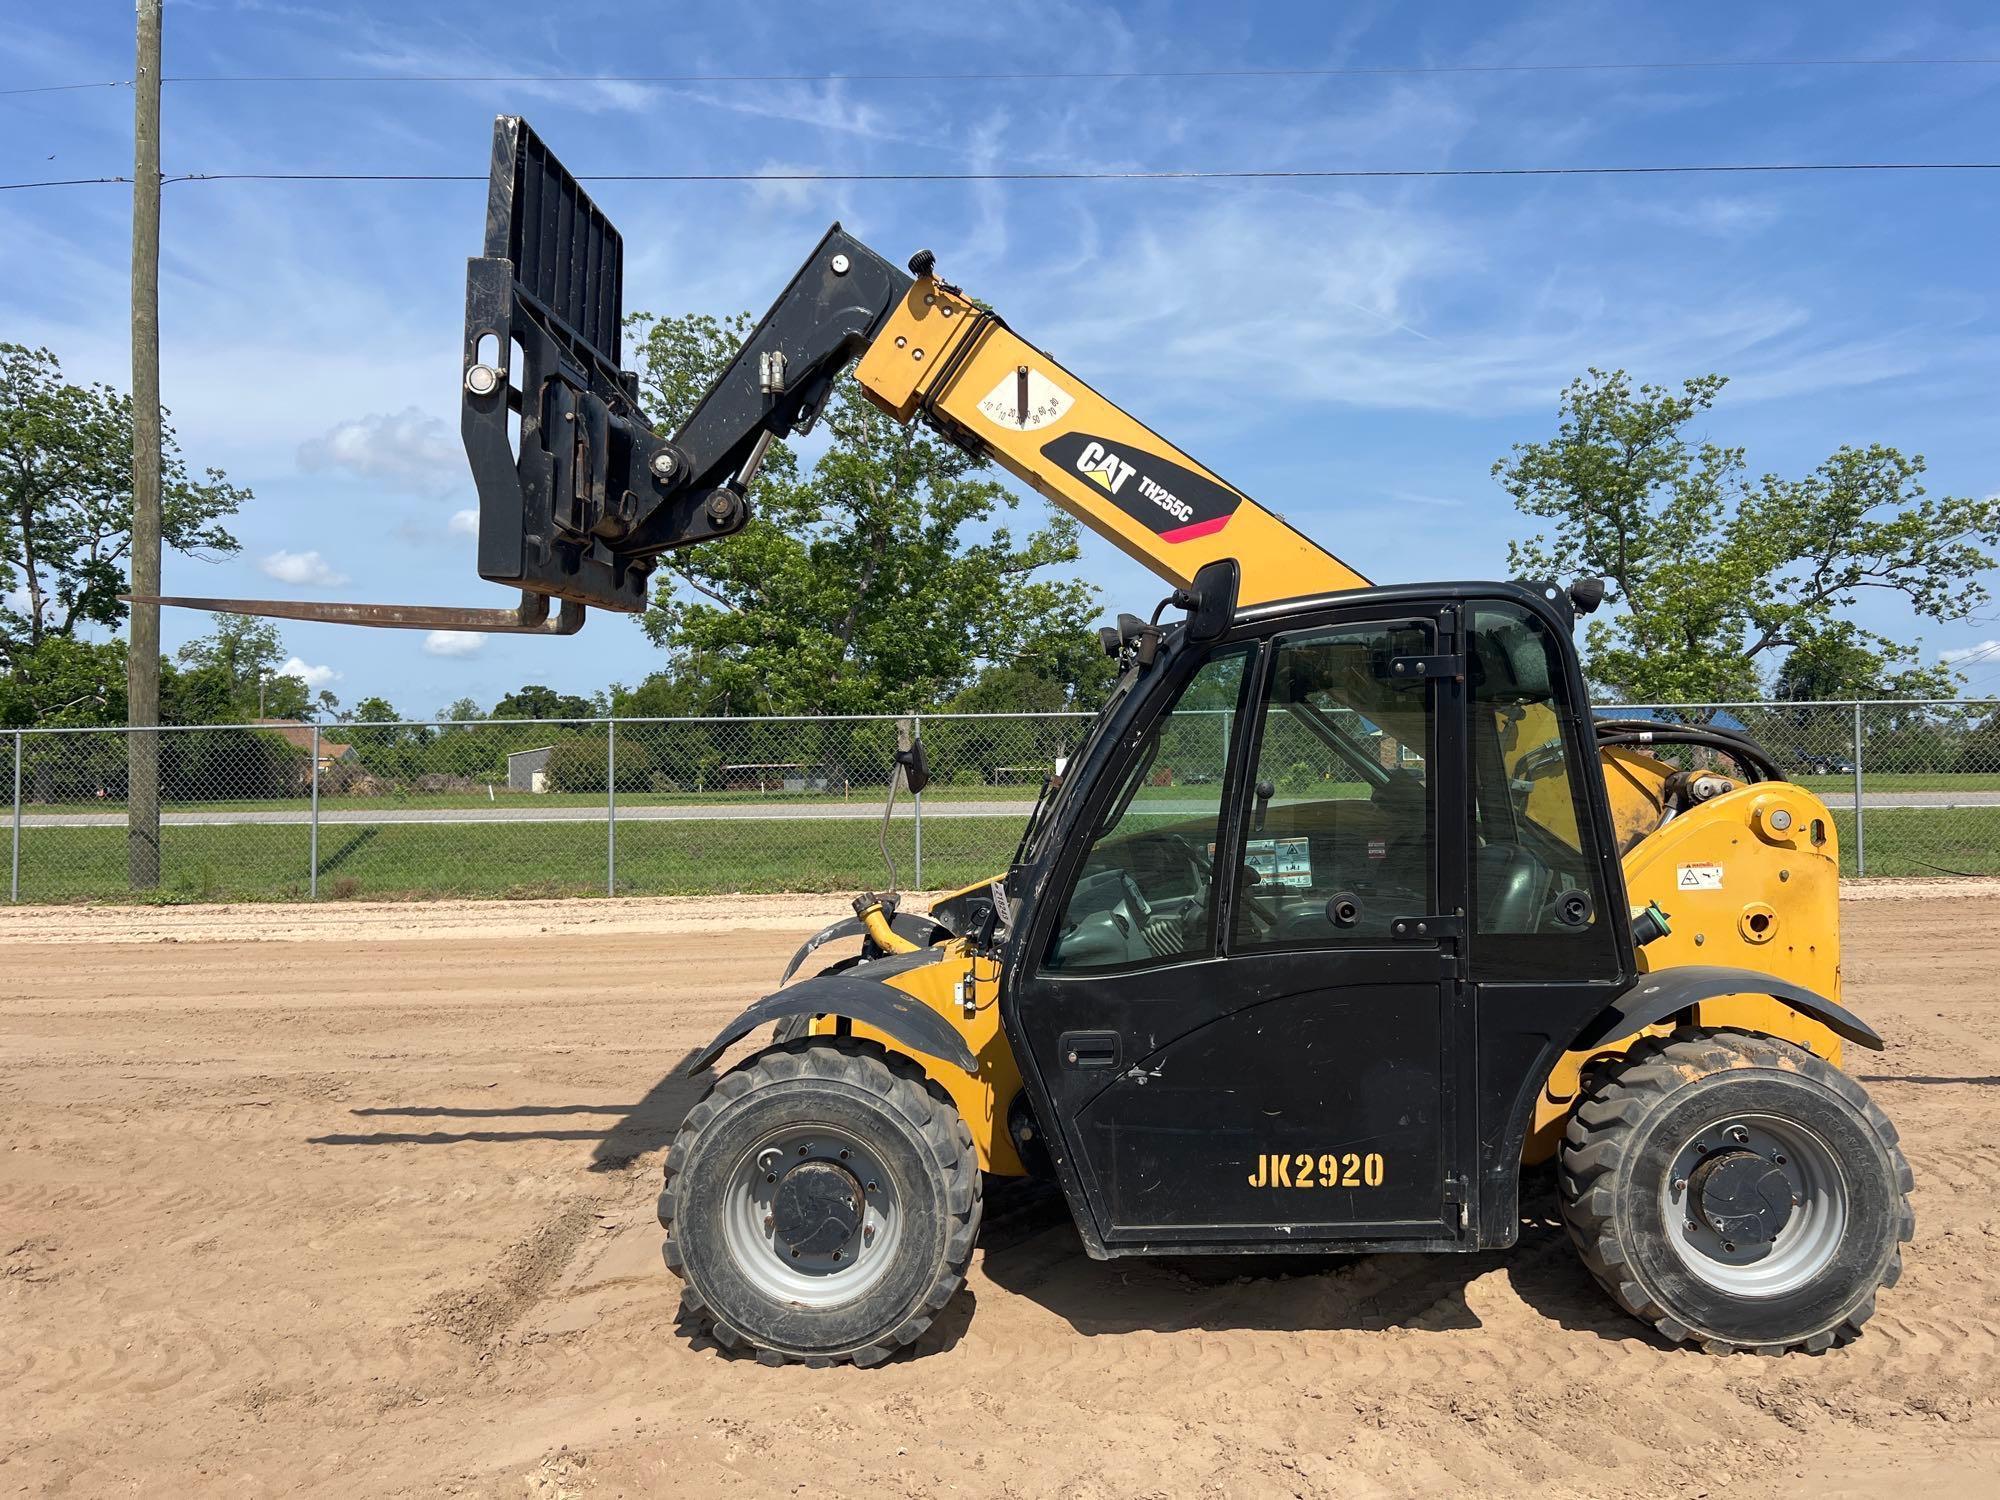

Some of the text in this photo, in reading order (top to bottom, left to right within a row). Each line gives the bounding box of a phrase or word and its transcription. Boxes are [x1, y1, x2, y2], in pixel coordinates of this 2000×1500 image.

[984, 401, 993, 411] -10
[996, 403, 1002, 411] 0
[1050, 398, 1059, 407] 80
[999, 411, 1007, 421] 10
[1008, 408, 1016, 418] 20
[1038, 406, 1047, 416] 60
[1048, 407, 1057, 417] 70
[1032, 414, 1040, 424] 50
[1076, 441, 1194, 523] CAT TH255C
[1248, 1153, 1384, 1188] JK2920
